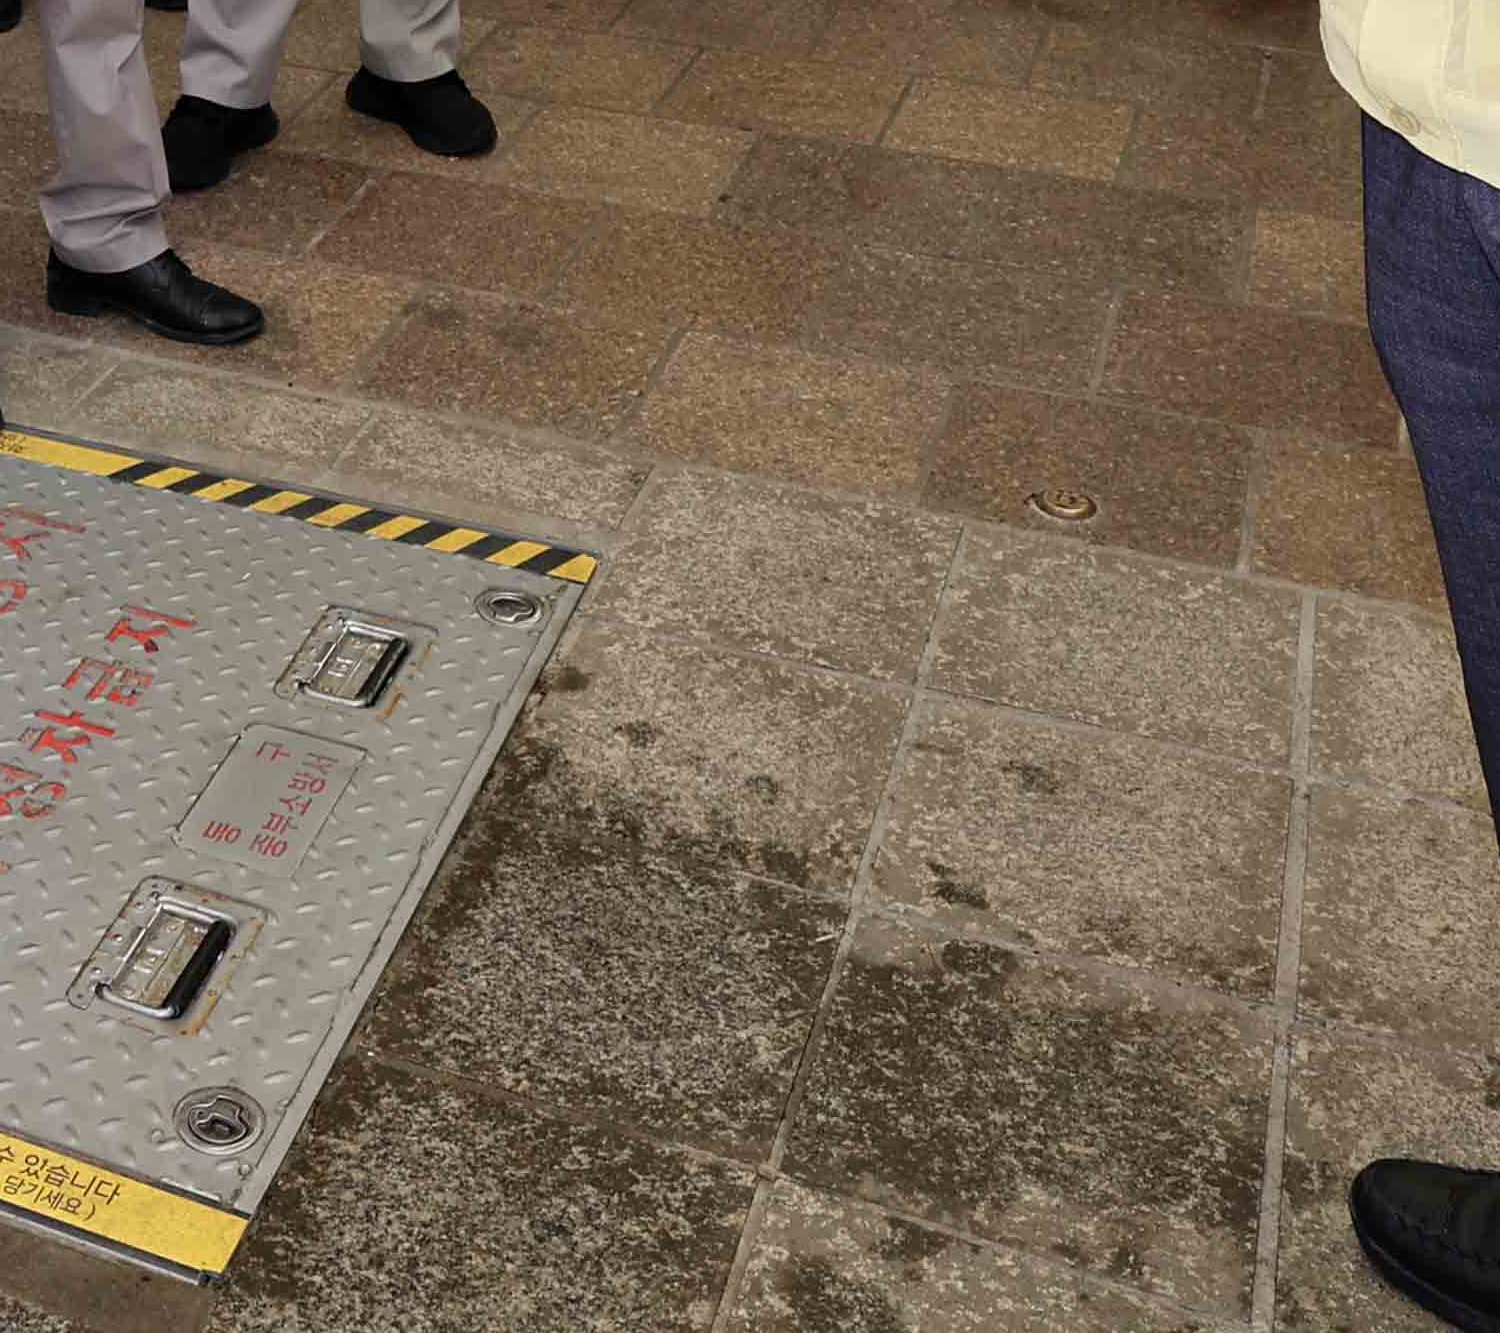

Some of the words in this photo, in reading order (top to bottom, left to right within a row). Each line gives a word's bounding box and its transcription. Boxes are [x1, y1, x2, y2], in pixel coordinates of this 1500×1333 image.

[202, 820, 242, 844] 동
[256, 740, 290, 762] 구
[249, 751, 340, 858] 중부소방서
[24, 1153, 122, 1206] 있습니다
